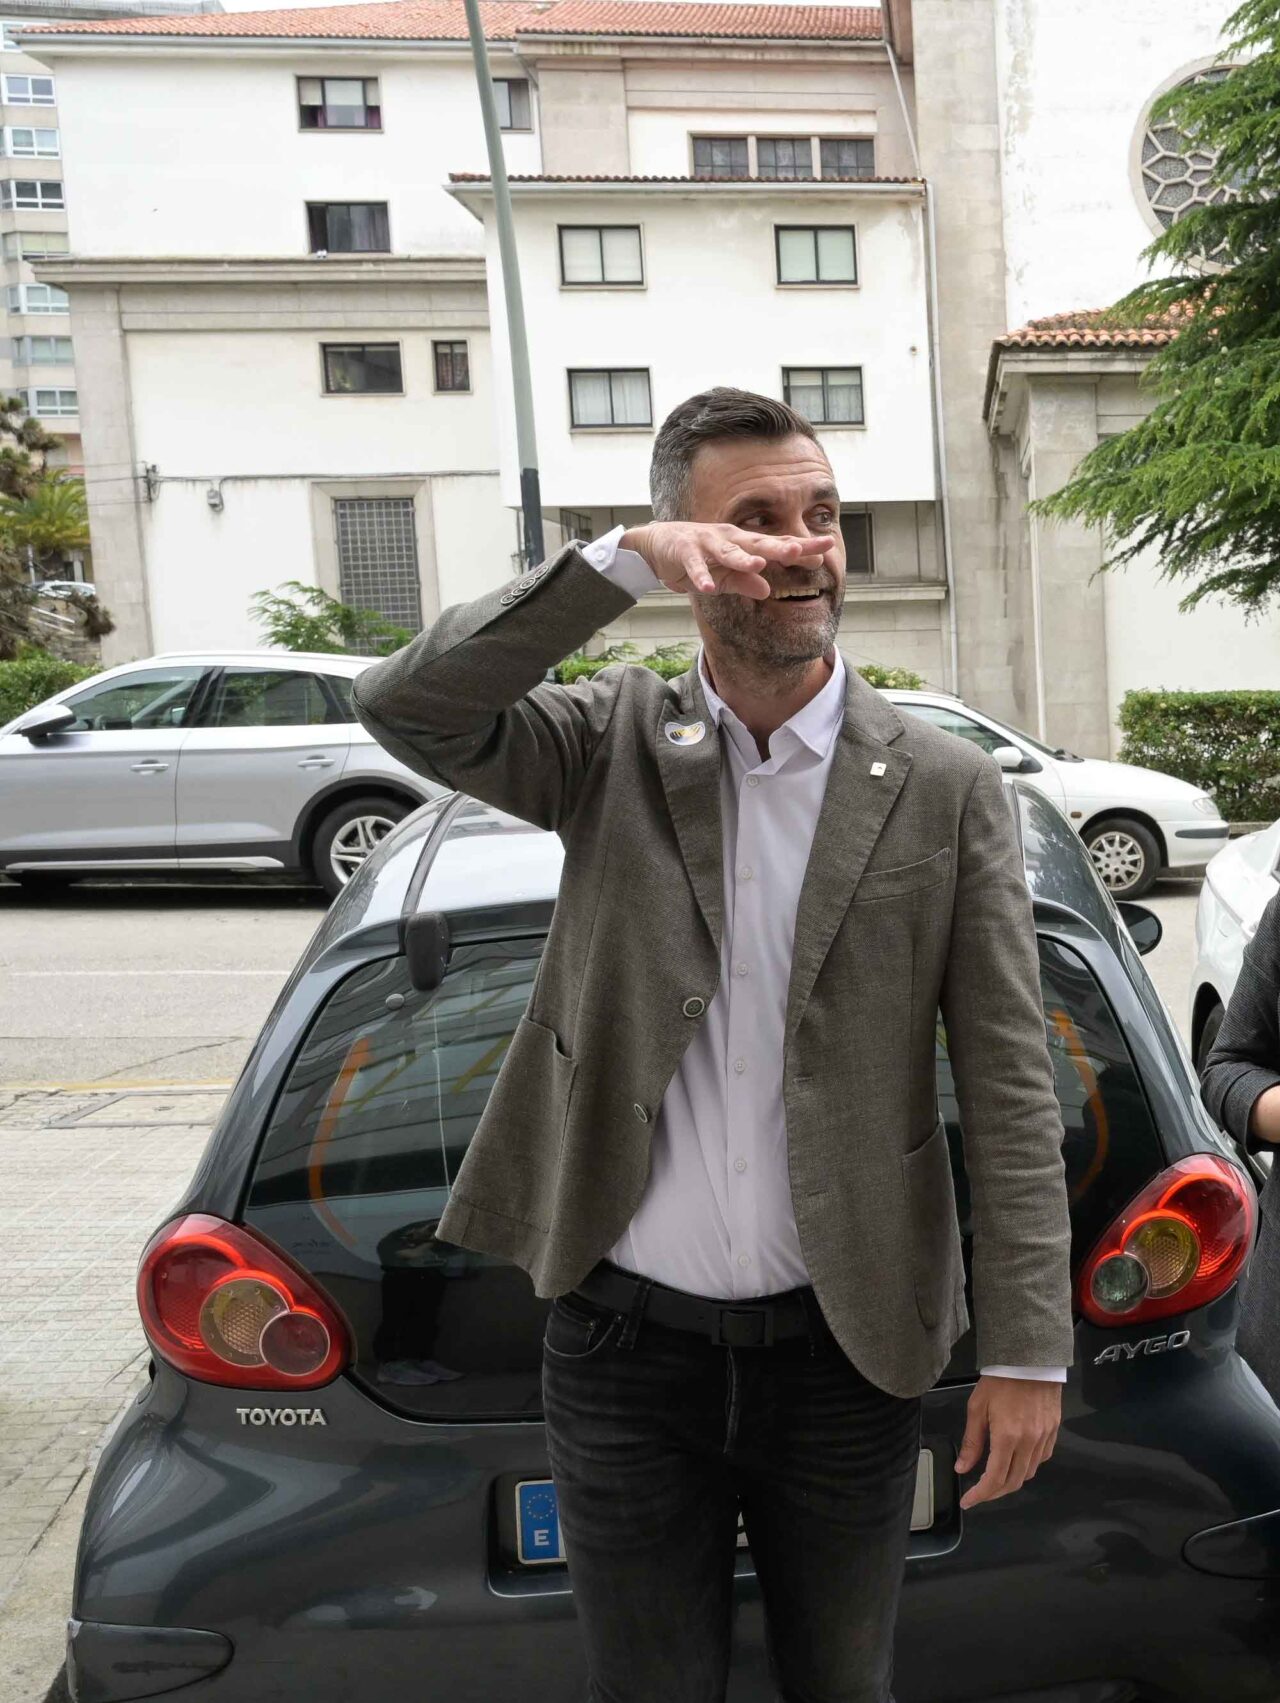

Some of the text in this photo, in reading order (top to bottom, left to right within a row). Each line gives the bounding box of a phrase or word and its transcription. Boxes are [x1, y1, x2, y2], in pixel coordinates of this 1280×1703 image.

[1094, 1330, 1191, 1365] AYGO
[236, 1408, 327, 1426] TOYOTA
[534, 1529, 550, 1546] E
